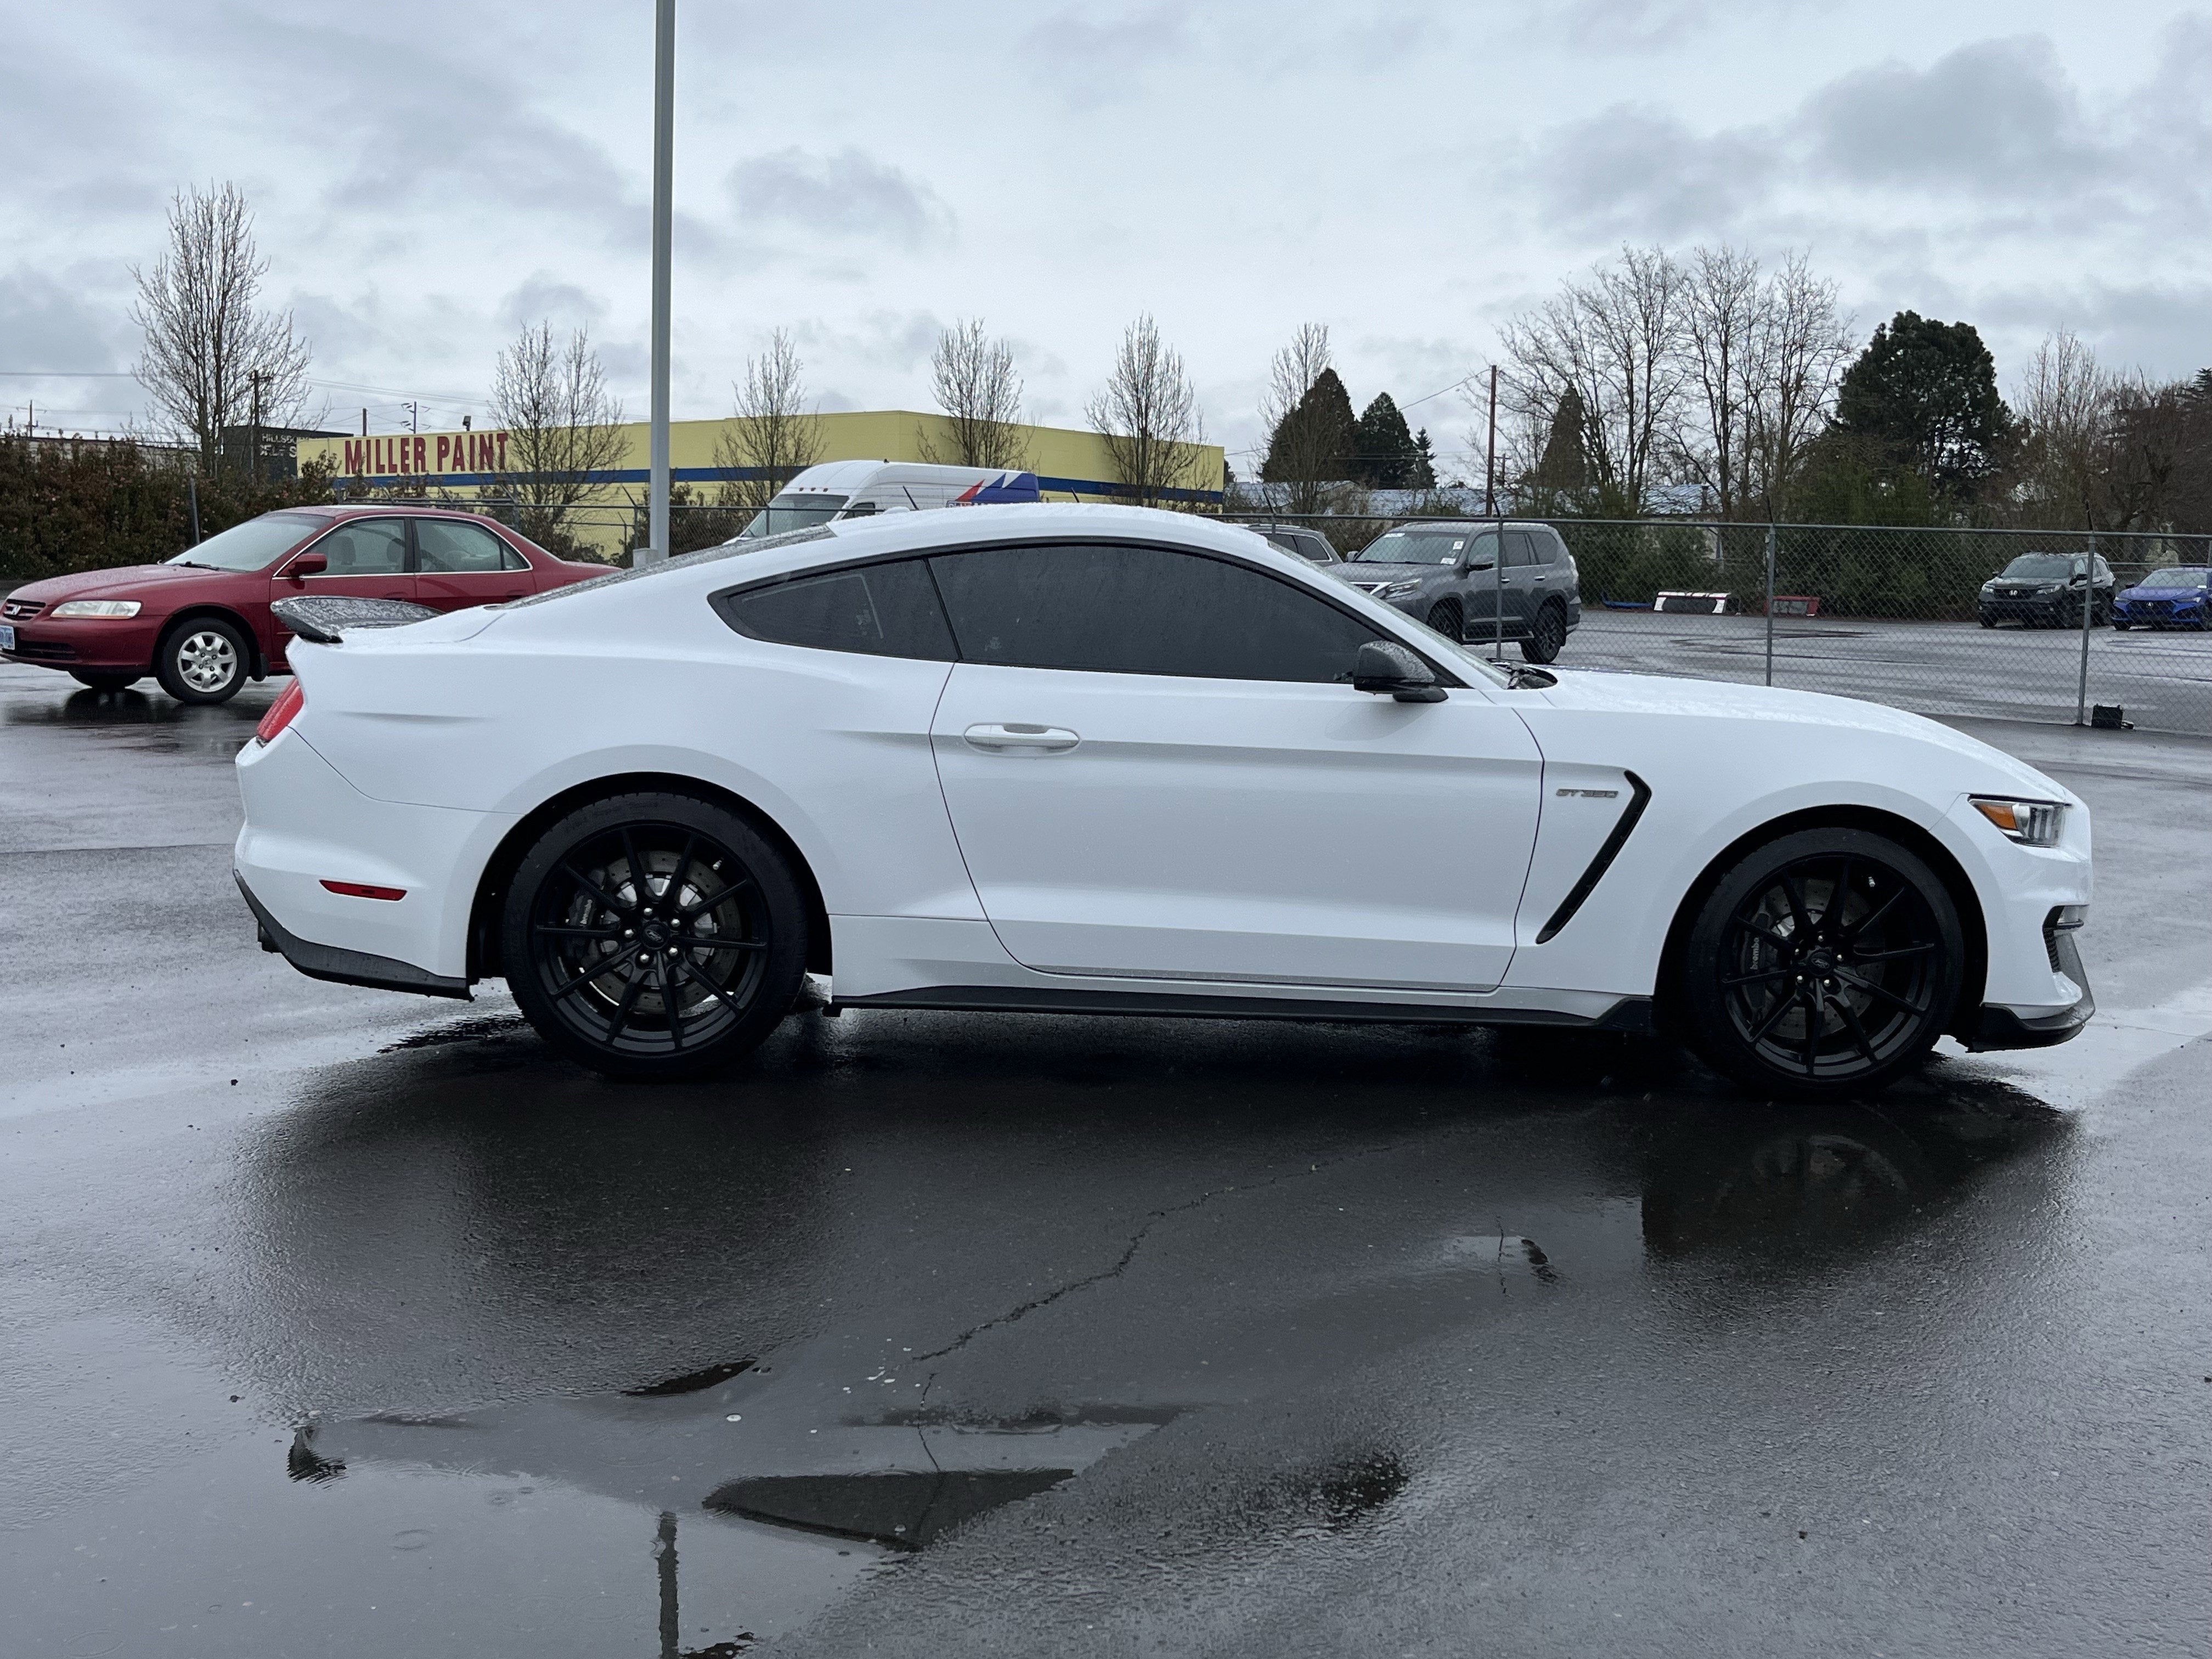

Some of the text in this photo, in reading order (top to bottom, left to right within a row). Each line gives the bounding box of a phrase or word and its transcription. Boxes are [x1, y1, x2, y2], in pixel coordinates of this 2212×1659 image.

[345, 433, 508, 475] MILLER PAINT
[1750, 937, 1760, 970] brembo
